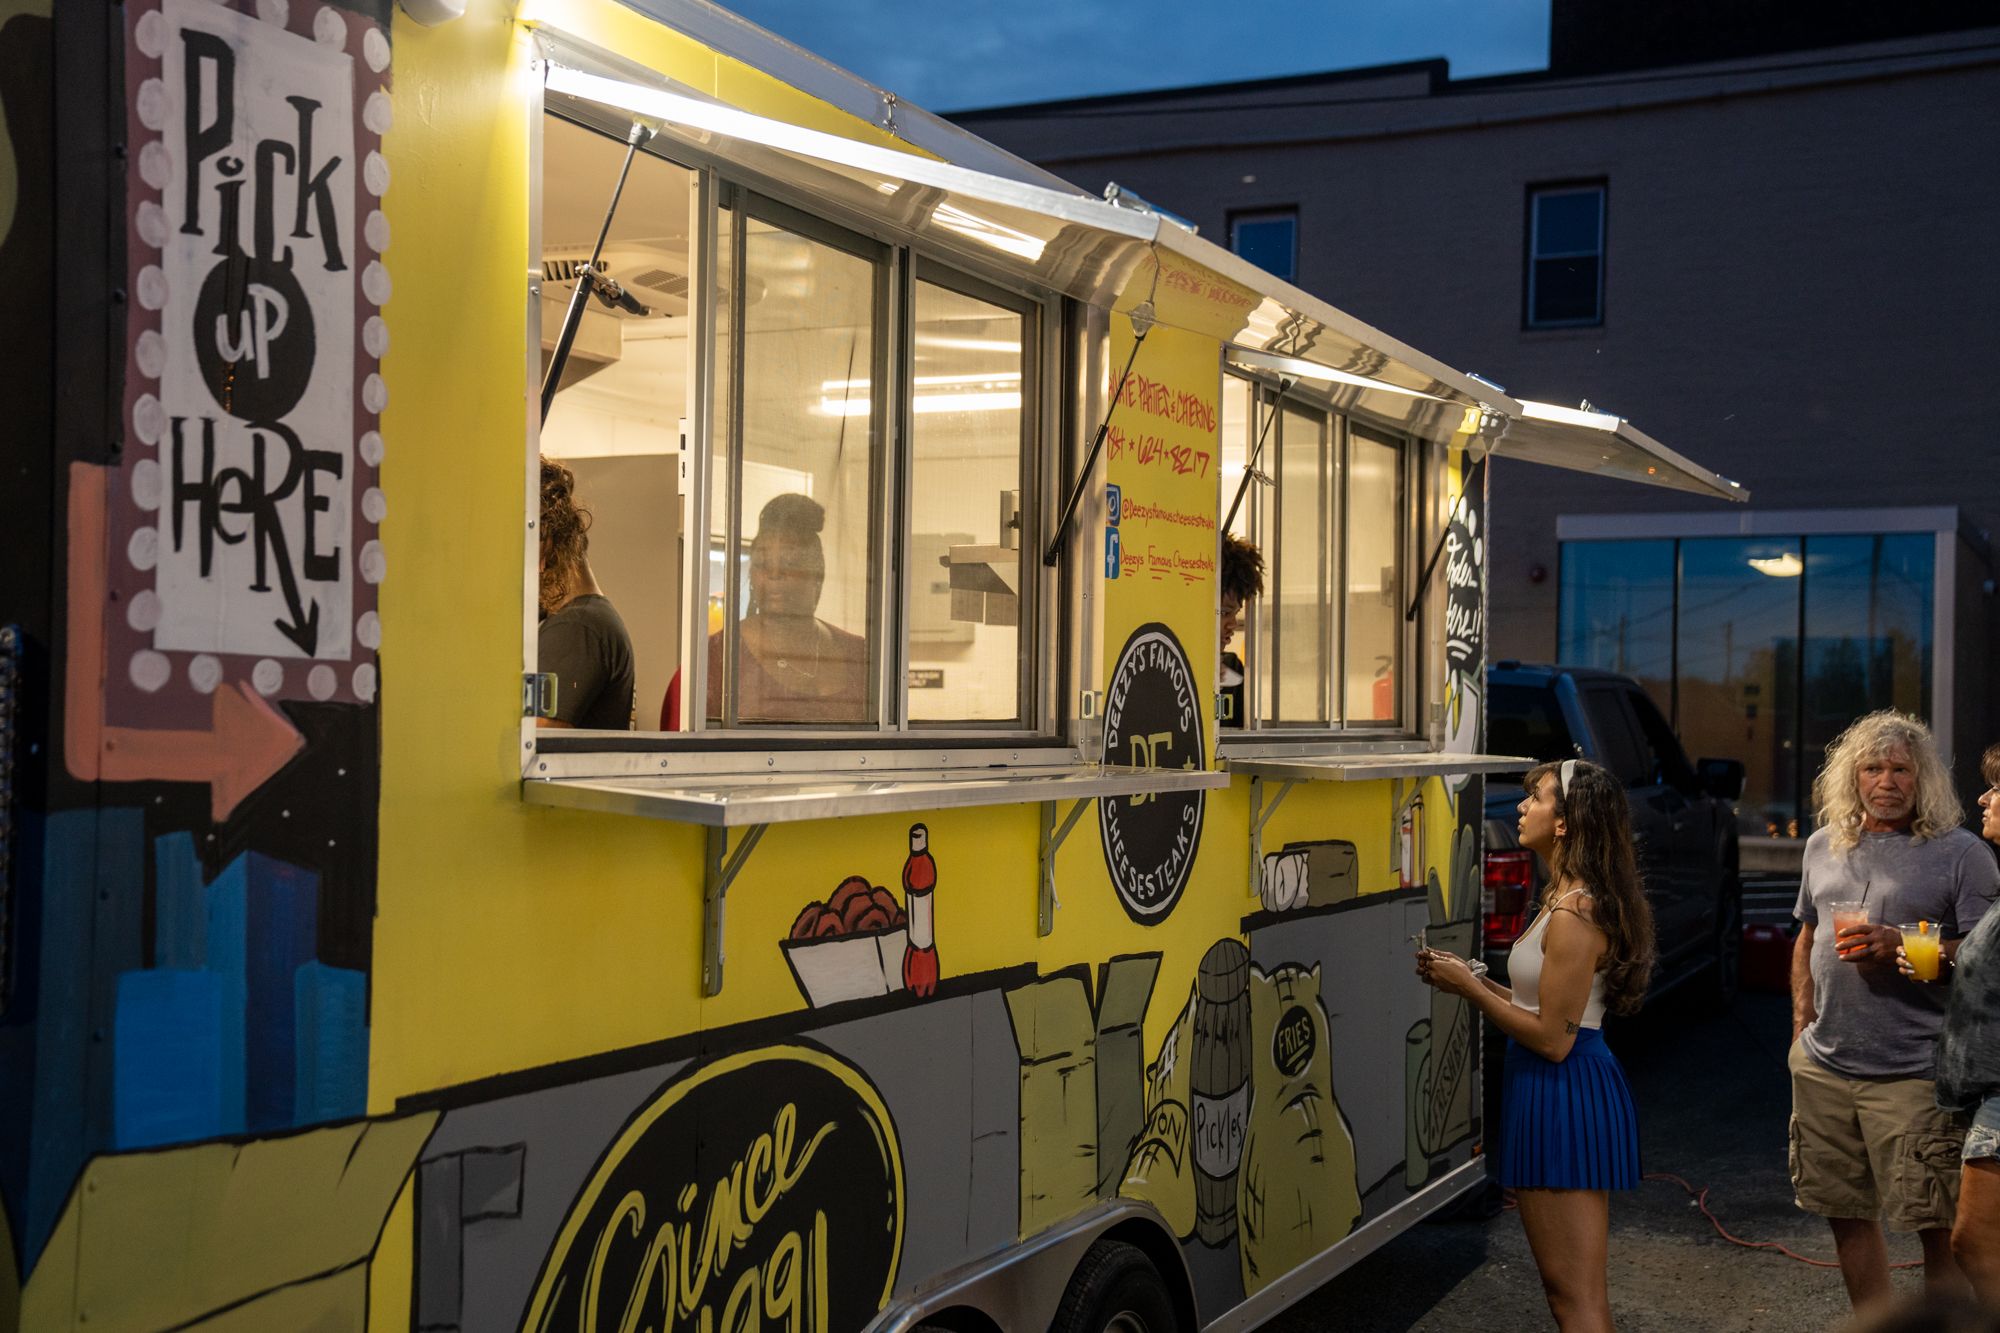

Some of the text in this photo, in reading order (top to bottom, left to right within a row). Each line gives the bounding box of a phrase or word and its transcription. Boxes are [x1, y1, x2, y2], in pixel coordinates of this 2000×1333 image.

[1108, 643, 1192, 749] DEEZY'S FAMOUS
[1107, 799, 1195, 900] CHEESESTEAKS
[1278, 1016, 1310, 1060] FRIES
